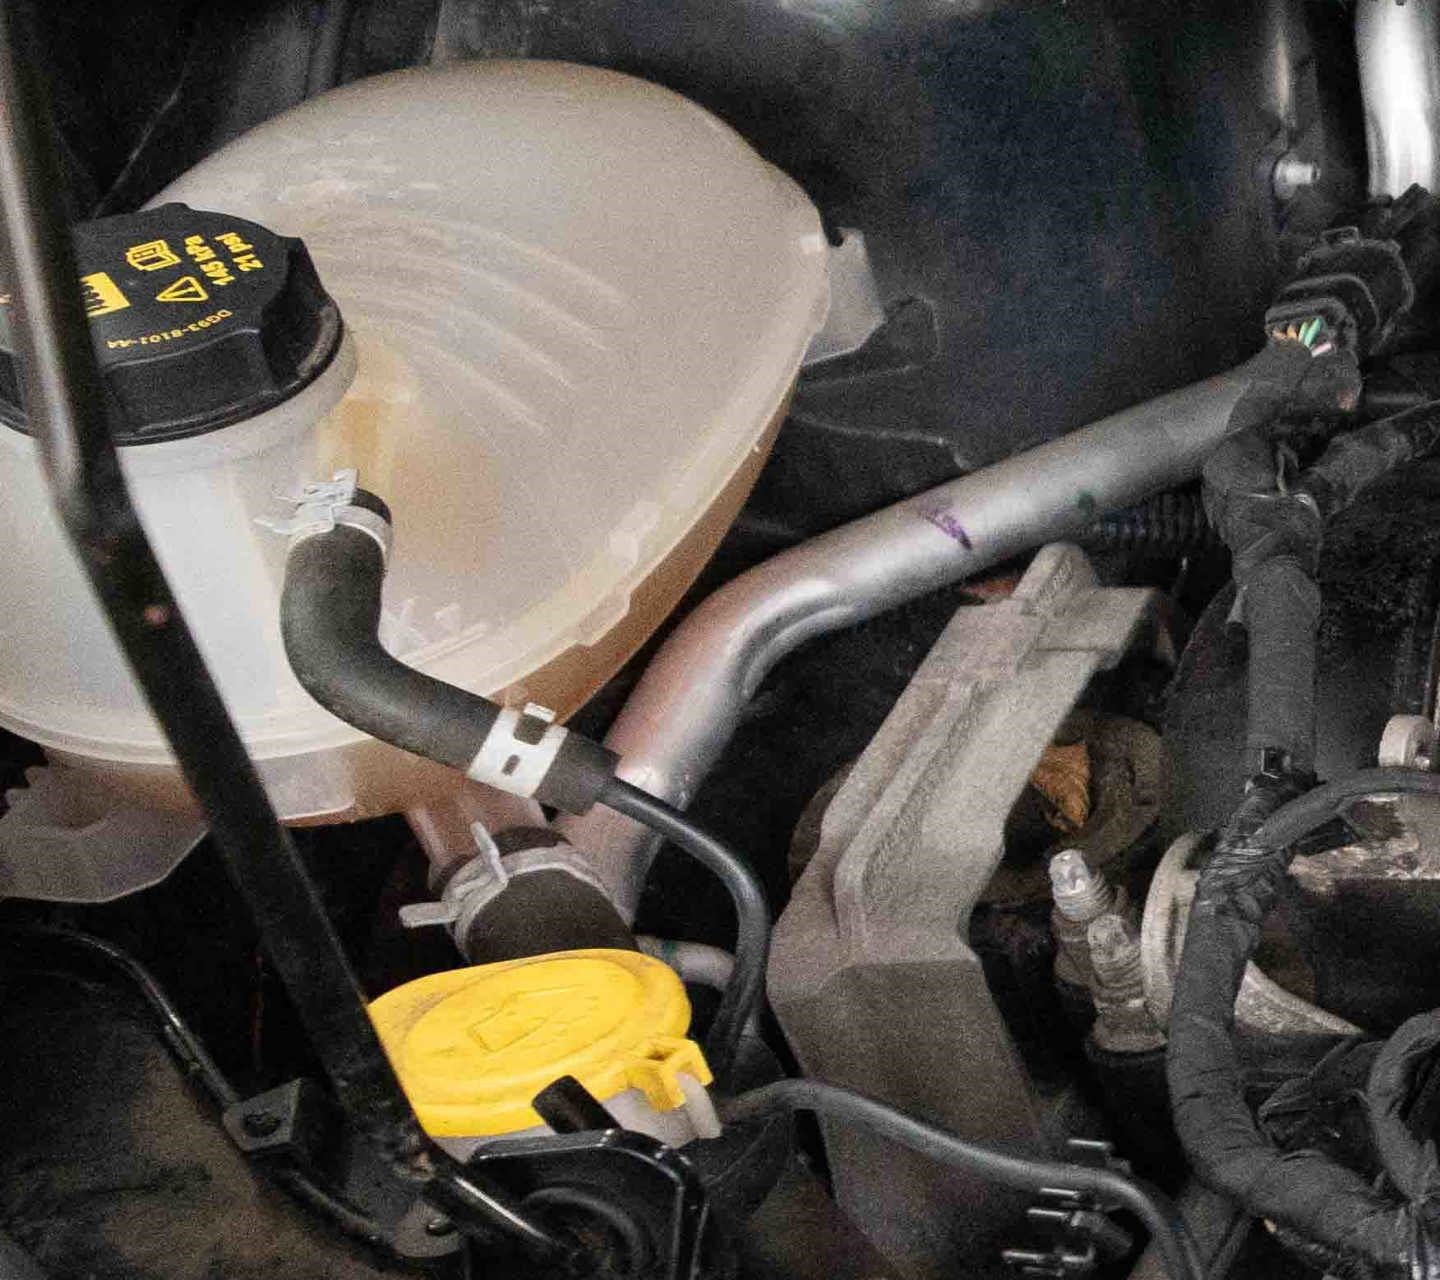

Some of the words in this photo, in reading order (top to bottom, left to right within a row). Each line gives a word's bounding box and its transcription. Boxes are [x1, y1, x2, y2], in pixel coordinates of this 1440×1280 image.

[183, 233, 216, 261] kPa
[214, 232, 253, 253] psi
[198, 260, 235, 287] 145
[231, 252, 264, 271] 21
